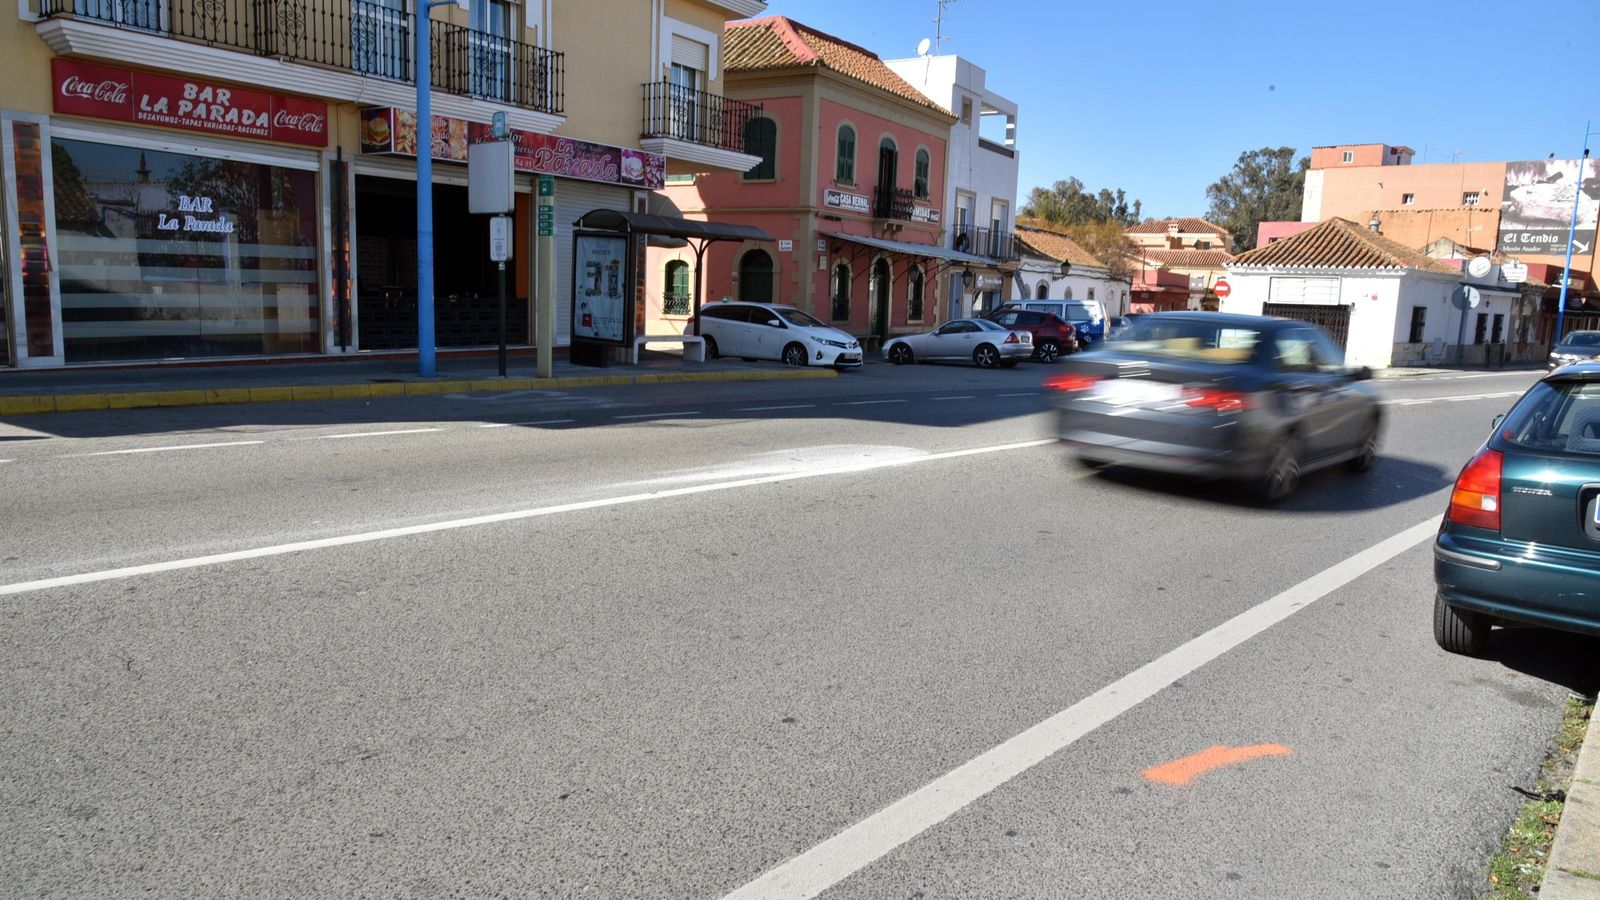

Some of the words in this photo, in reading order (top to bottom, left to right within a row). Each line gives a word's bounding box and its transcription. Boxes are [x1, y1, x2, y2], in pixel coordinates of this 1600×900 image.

[183, 83, 231, 106] BAR
[140, 94, 168, 113] LA
[177, 99, 269, 128] PARADA
[431, 116, 447, 128] ollo
[554, 138, 574, 156] La
[535, 147, 619, 182] Parada
[178, 195, 214, 213] BAR
[840, 193, 852, 205] CASA
[852, 196, 869, 207] BERNAL
[157, 213, 179, 230] La
[183, 215, 234, 233] Parada
[1503, 233, 1517, 243] El
